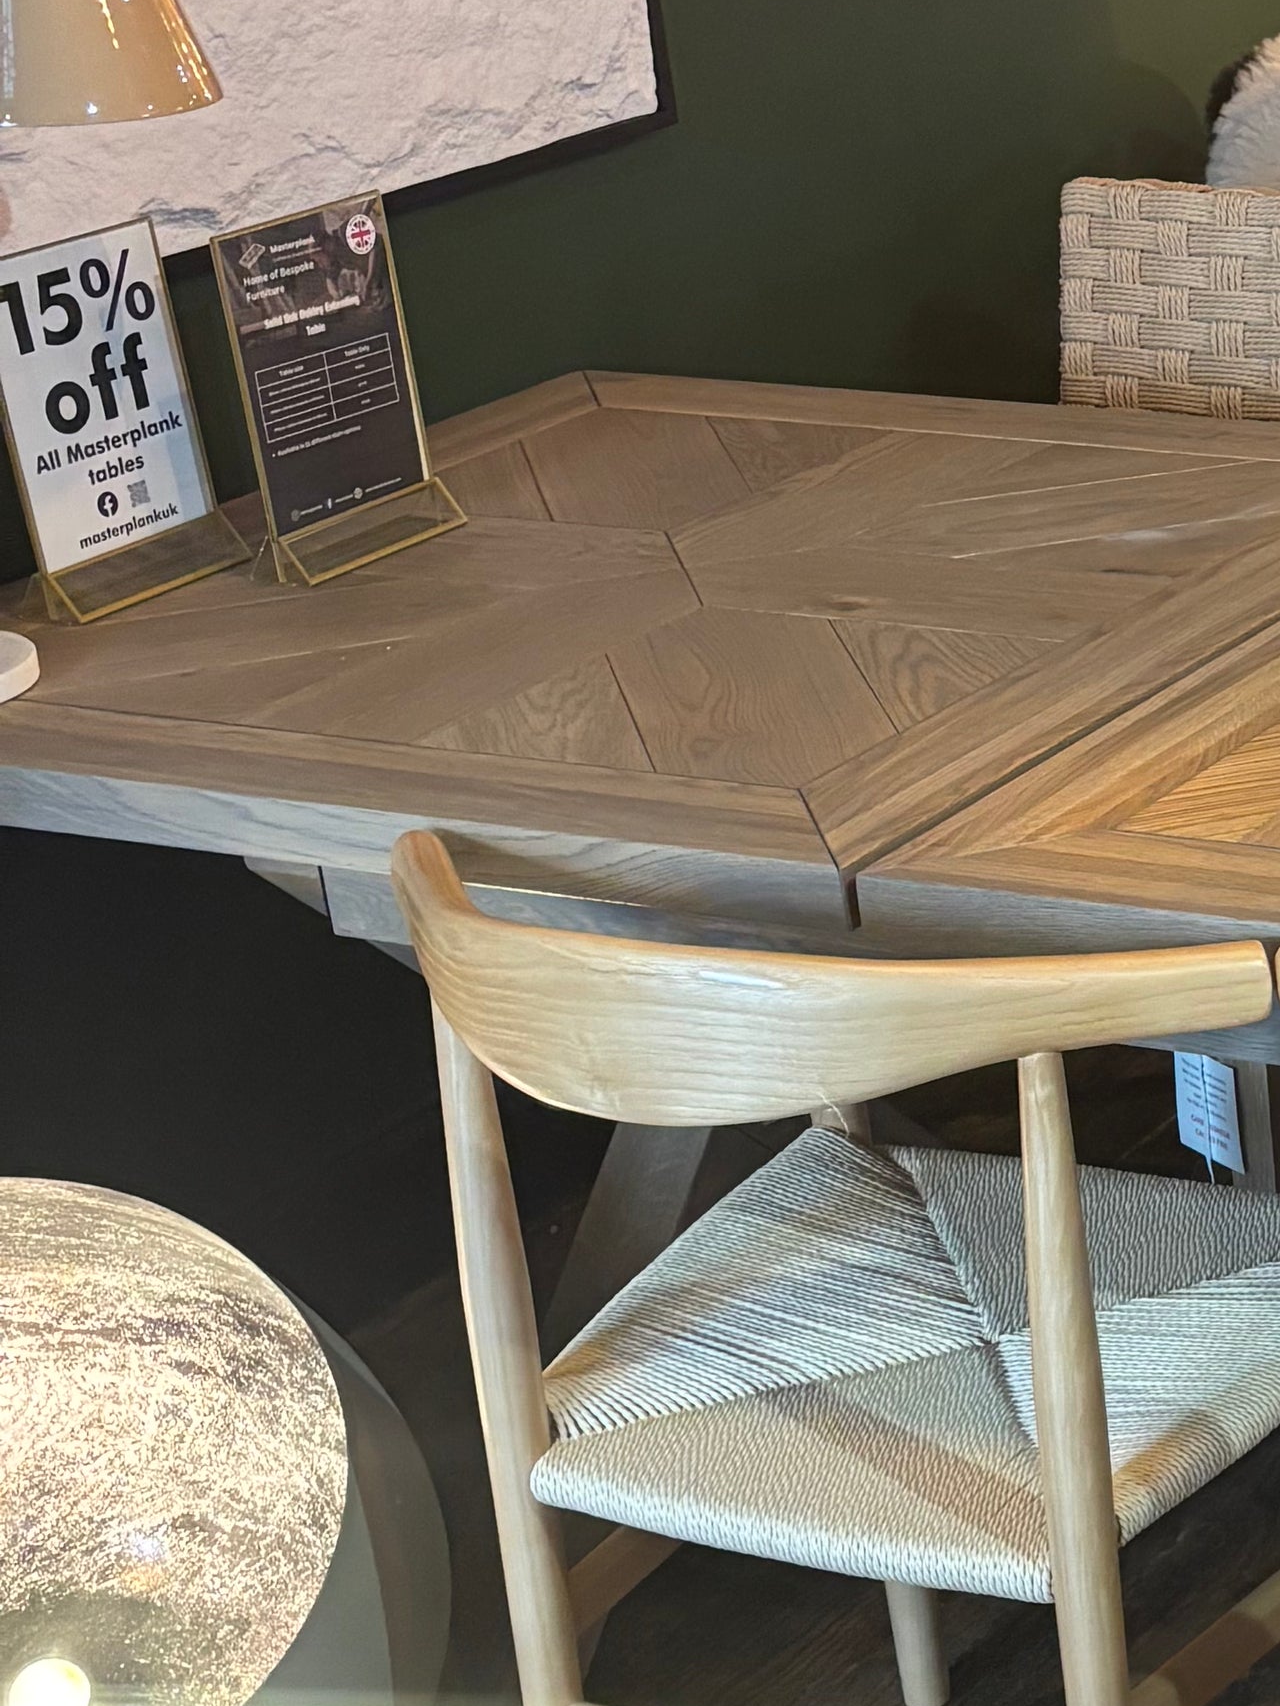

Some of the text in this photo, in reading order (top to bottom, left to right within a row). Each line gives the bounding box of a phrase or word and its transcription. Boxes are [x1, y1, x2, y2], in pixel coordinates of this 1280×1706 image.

[243, 260, 315, 287] Home of Bespoke
[246, 284, 286, 303] Furniture
[0, 248, 156, 356] 15%
[45, 331, 151, 435] off
[36, 410, 183, 475] All Masterplank
[88, 454, 146, 486] tables
[79, 503, 180, 550] masterplankuk
